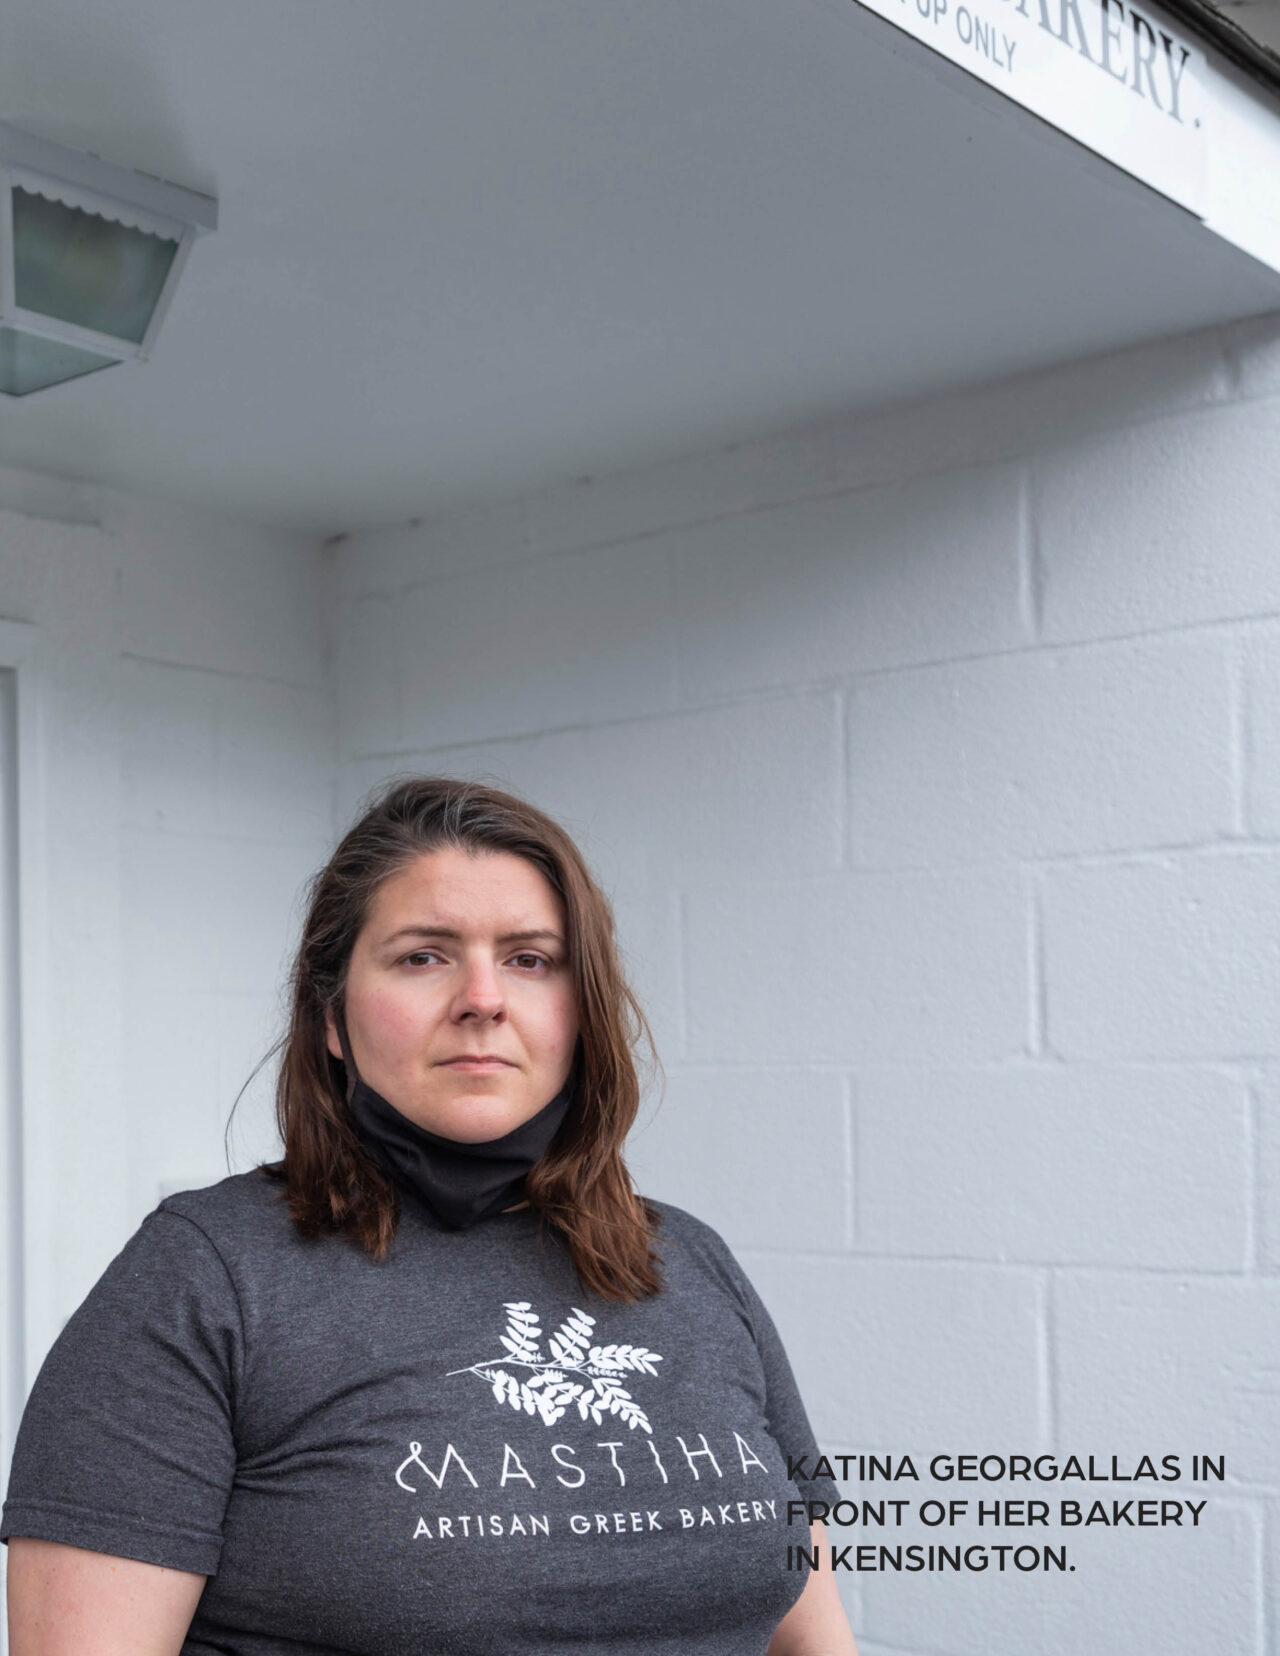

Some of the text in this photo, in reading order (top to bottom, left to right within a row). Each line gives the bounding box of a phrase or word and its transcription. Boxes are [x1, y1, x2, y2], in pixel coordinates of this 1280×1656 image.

[955, 5, 1016, 73] ONLY
[395, 1431, 769, 1493] MASTIHA
[412, 1499, 777, 1539] ARTISAN GREEK BAKERY
